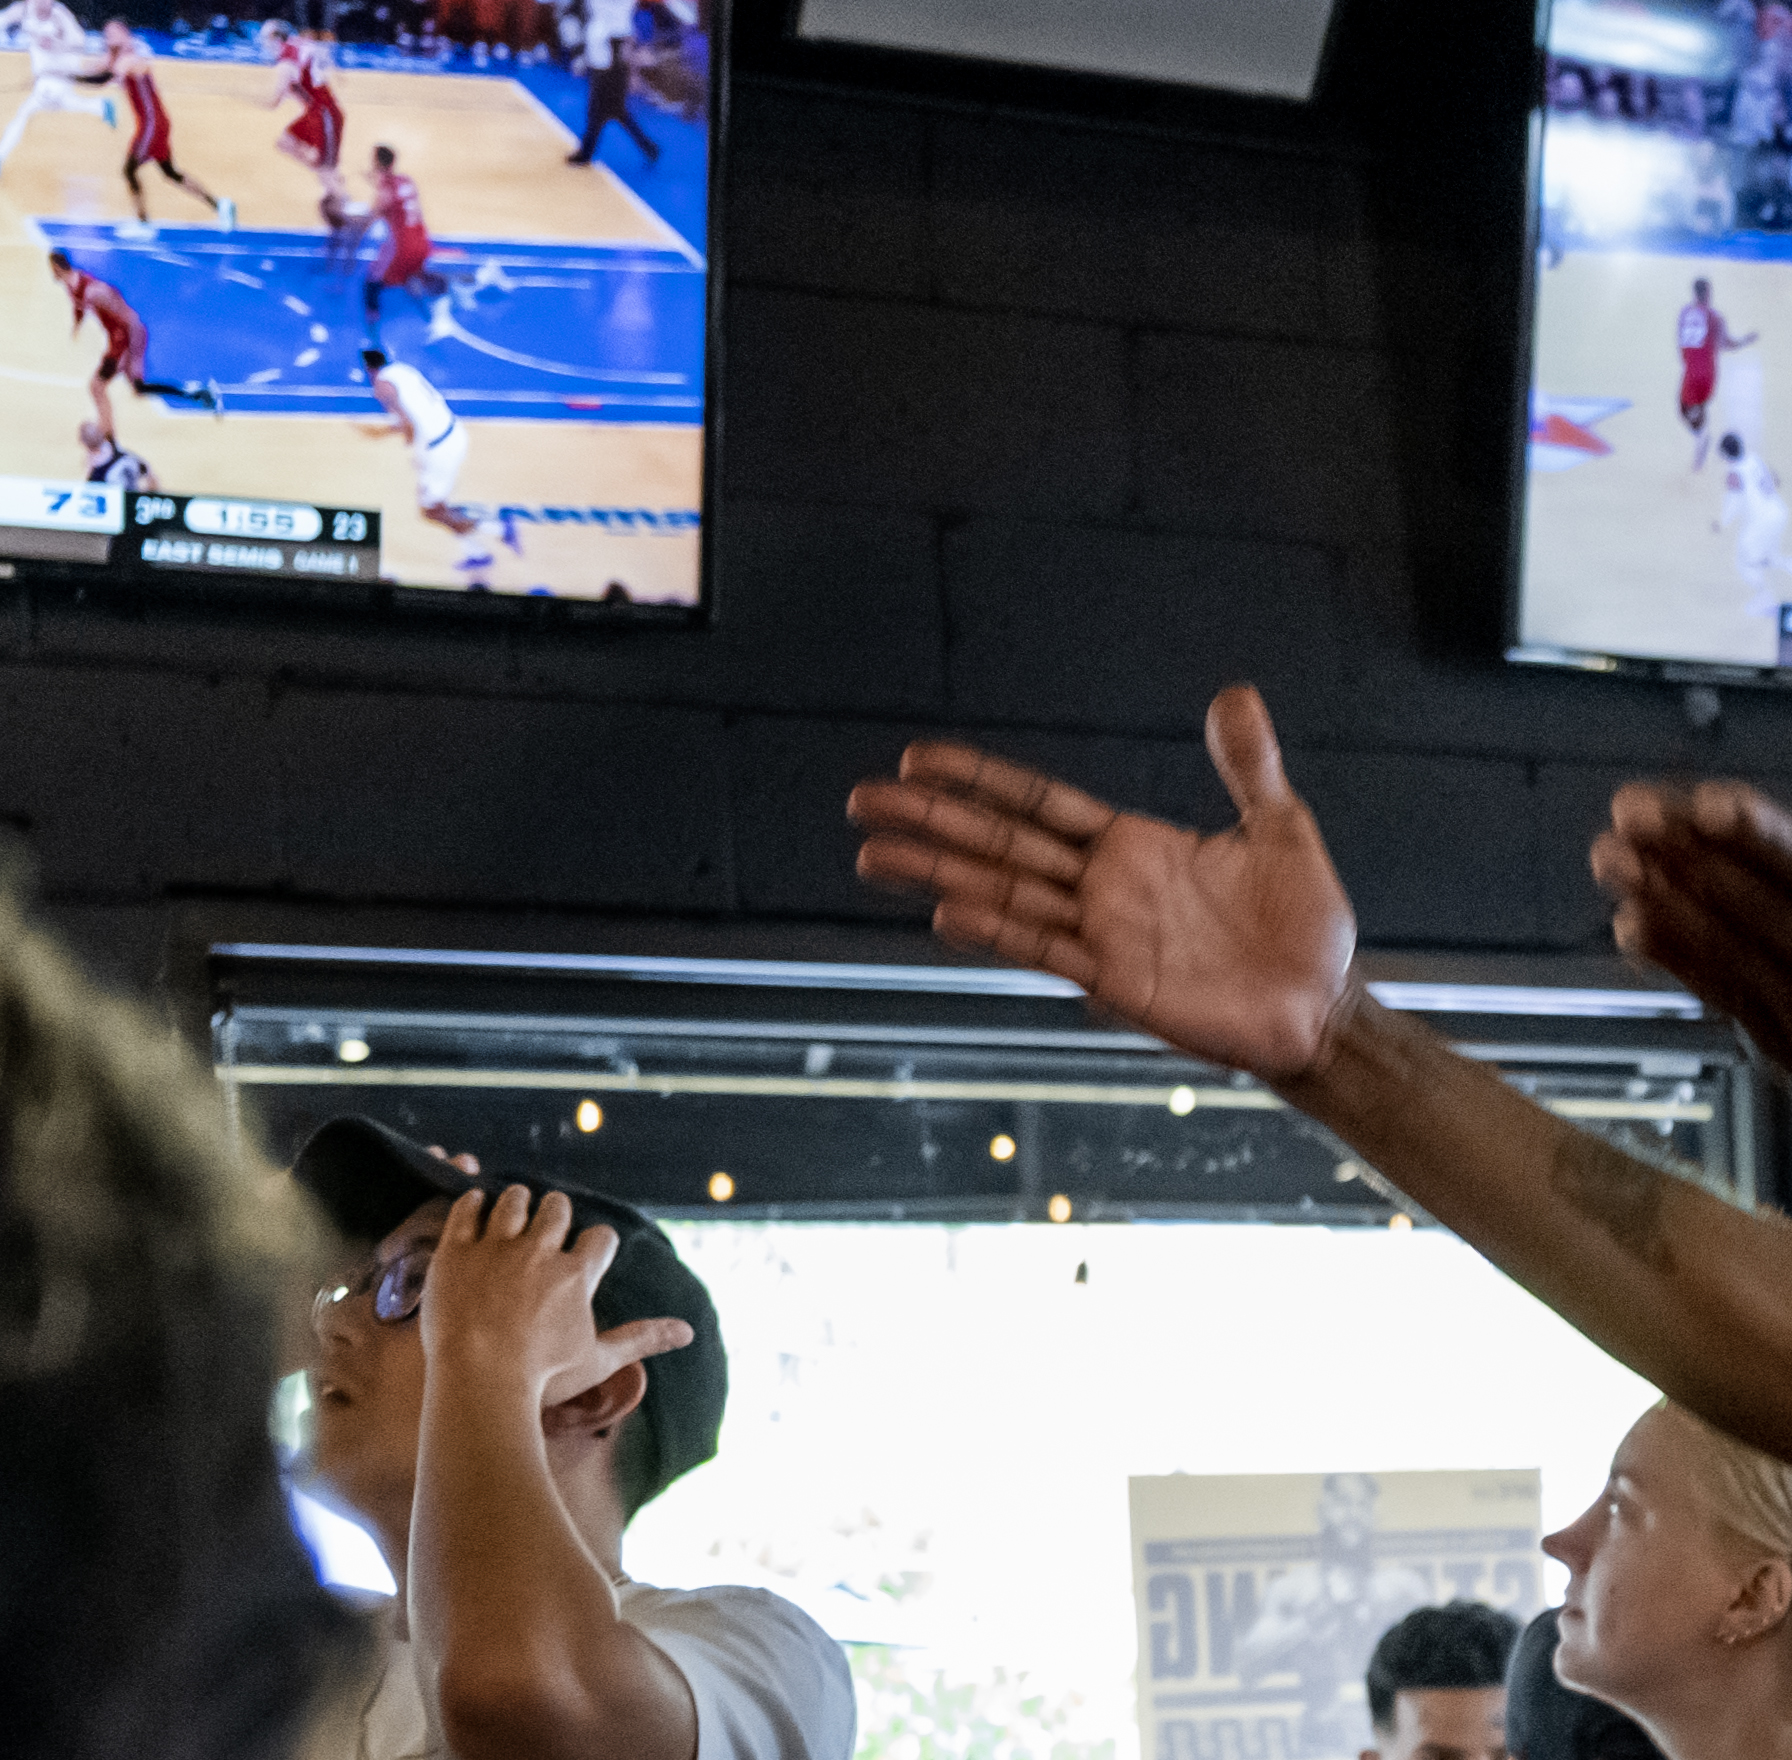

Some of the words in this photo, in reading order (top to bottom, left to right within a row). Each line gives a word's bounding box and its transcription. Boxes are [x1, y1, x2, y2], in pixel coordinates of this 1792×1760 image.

[42, 487, 108, 517] 73
[141, 537, 204, 565] EAST
[207, 542, 284, 571] SEMIS
